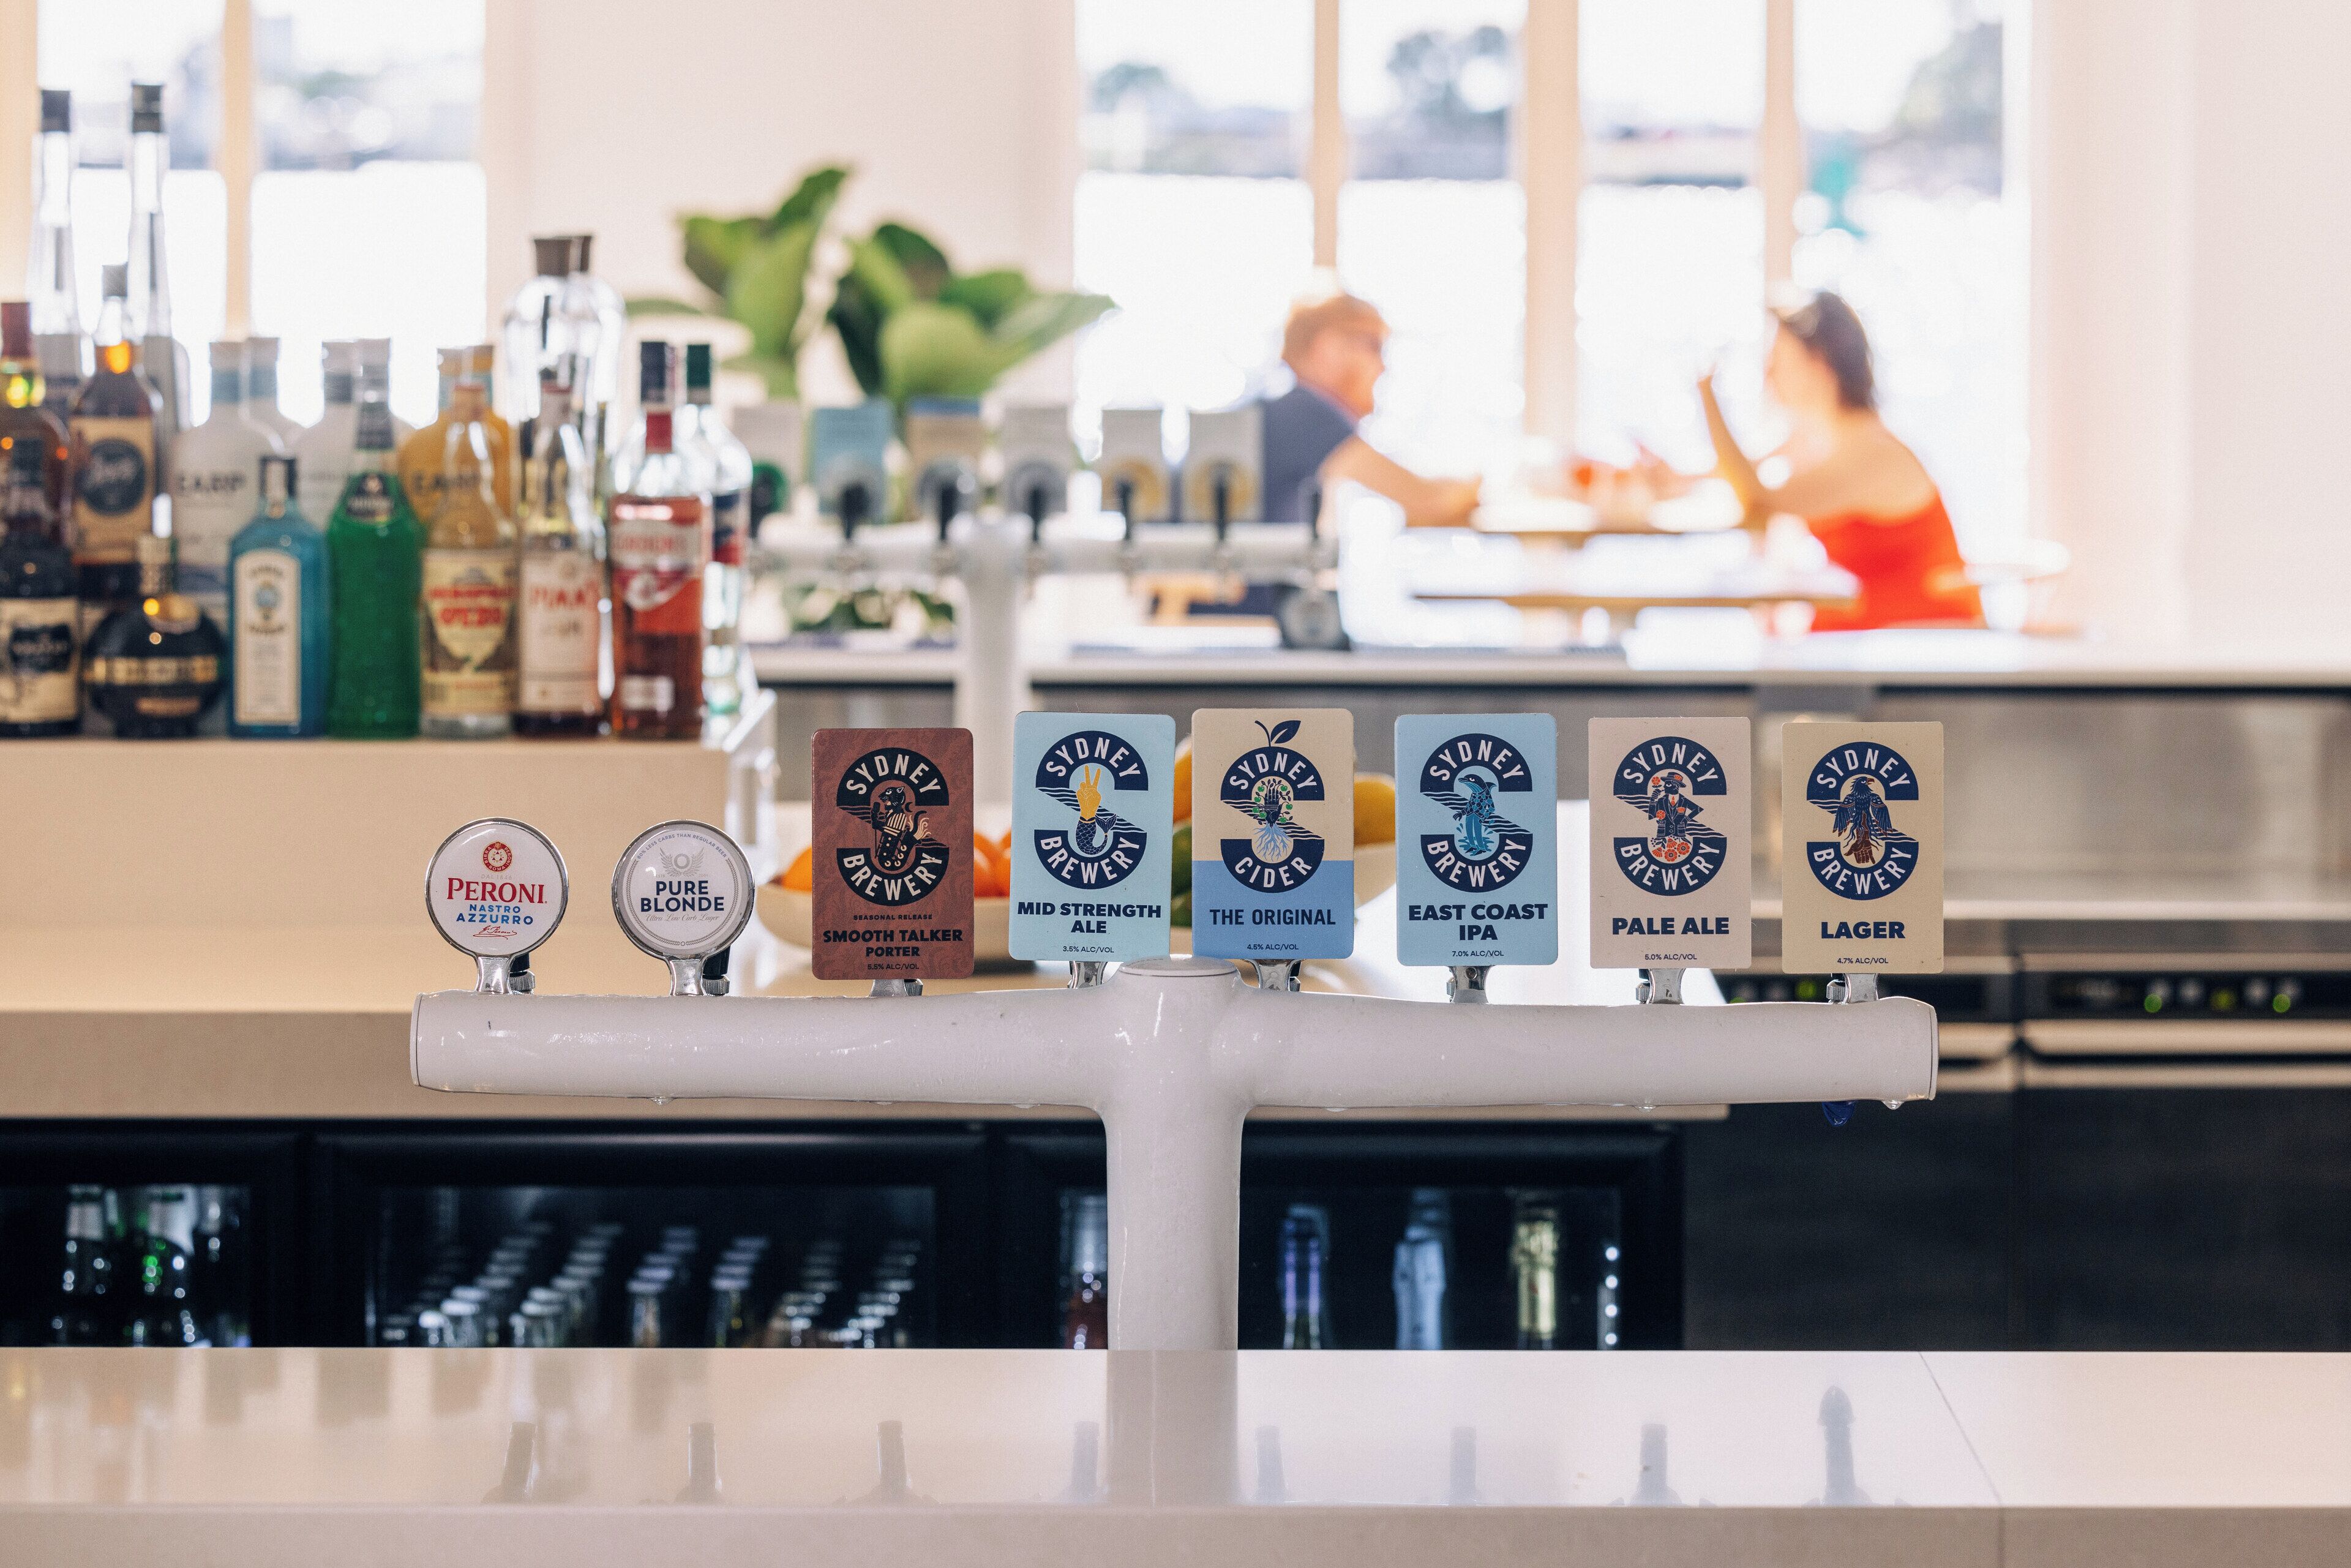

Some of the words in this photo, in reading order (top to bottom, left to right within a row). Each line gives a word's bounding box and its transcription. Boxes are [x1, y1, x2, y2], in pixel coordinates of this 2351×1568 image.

[1046, 737, 1141, 778] SYDNEY
[1430, 740, 1524, 781] SYDNEY
[1623, 743, 1719, 784] SYDNEY
[846, 754, 941, 795] SYDNEY
[1229, 752, 1317, 790] SYDNEY
[1816, 748, 1910, 789] SYDNEY
[483, 846, 492, 864] BIRRA
[637, 850, 646, 859] 80%
[646, 841, 658, 850] LESS
[658, 834, 675, 842] CARBS
[693, 835, 716, 847] REGULAR
[715, 846, 727, 858] BEER
[1040, 836, 1140, 884] BREWERY
[1427, 839, 1526, 887] BREWERY
[1620, 842, 1720, 890] BREWERY
[843, 852, 942, 901] BREWERY
[1235, 857, 1312, 888] CIDER
[1813, 847, 1912, 895] BREWERY
[447, 877, 545, 904] PERONI
[656, 880, 708, 896] PURE
[470, 904, 520, 913] NASTRO
[640, 896, 724, 912] BLONDE
[1018, 901, 1056, 915] MID
[1060, 902, 1161, 918] STRENGTH
[1409, 904, 1466, 921] EAST
[1471, 904, 1548, 920] COAST
[456, 913, 533, 925] AZZURRO
[646, 913, 662, 921] Ultra
[664, 913, 680, 922] Low
[697, 913, 720, 923] Lager
[1209, 909, 1244, 925] THE
[1252, 909, 1336, 925] ORIGINAL
[1612, 917, 1675, 935] PALE
[1681, 917, 1730, 934] ALE
[823, 929, 894, 943] SMOOTH
[899, 929, 963, 942] TALKER
[1071, 920, 1106, 934] ALE
[1459, 925, 1498, 940] IPA
[1821, 921, 1906, 939] LAGER
[866, 946, 920, 957] PORTER
